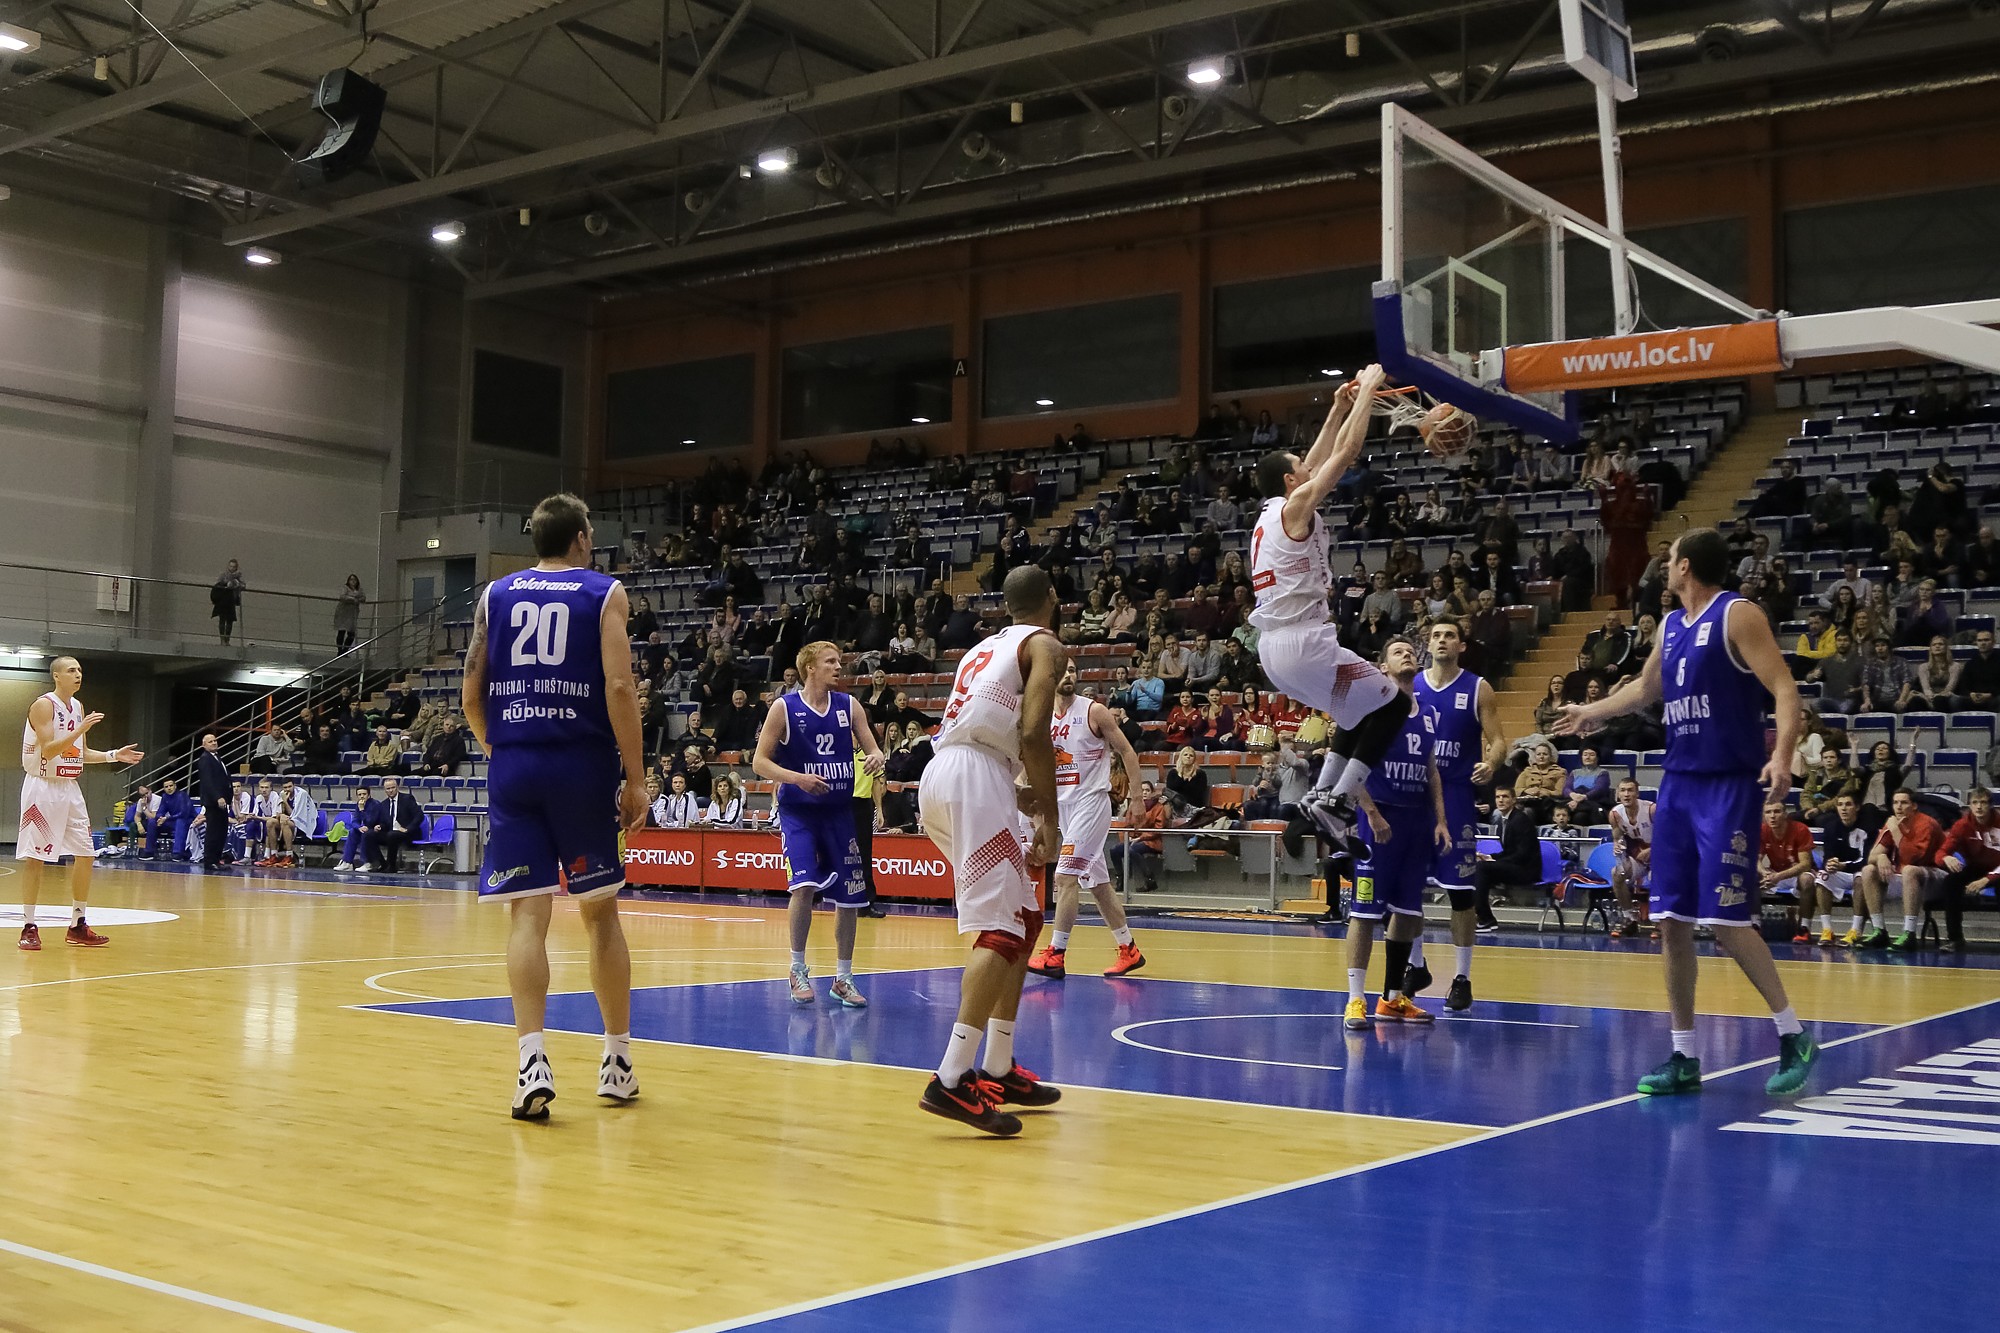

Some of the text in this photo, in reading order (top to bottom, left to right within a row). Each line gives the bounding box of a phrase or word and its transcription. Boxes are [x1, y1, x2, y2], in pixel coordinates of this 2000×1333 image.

[1562, 337, 1715, 374] www.loc.lv
[955, 360, 965, 376] A
[508, 577, 584, 592] Solotransa
[510, 601, 570, 667] 20
[533, 677, 590, 698] BIRŠTONAS
[67, 719, 75, 732] 4
[815, 733, 836, 756] 22
[1405, 732, 1422, 755] 12
[803, 761, 854, 780] VYTAUTAS
[43, 843, 53, 856] 4
[624, 848, 695, 866] SPORTLAND
[871, 857, 947, 877] PORTLAND
